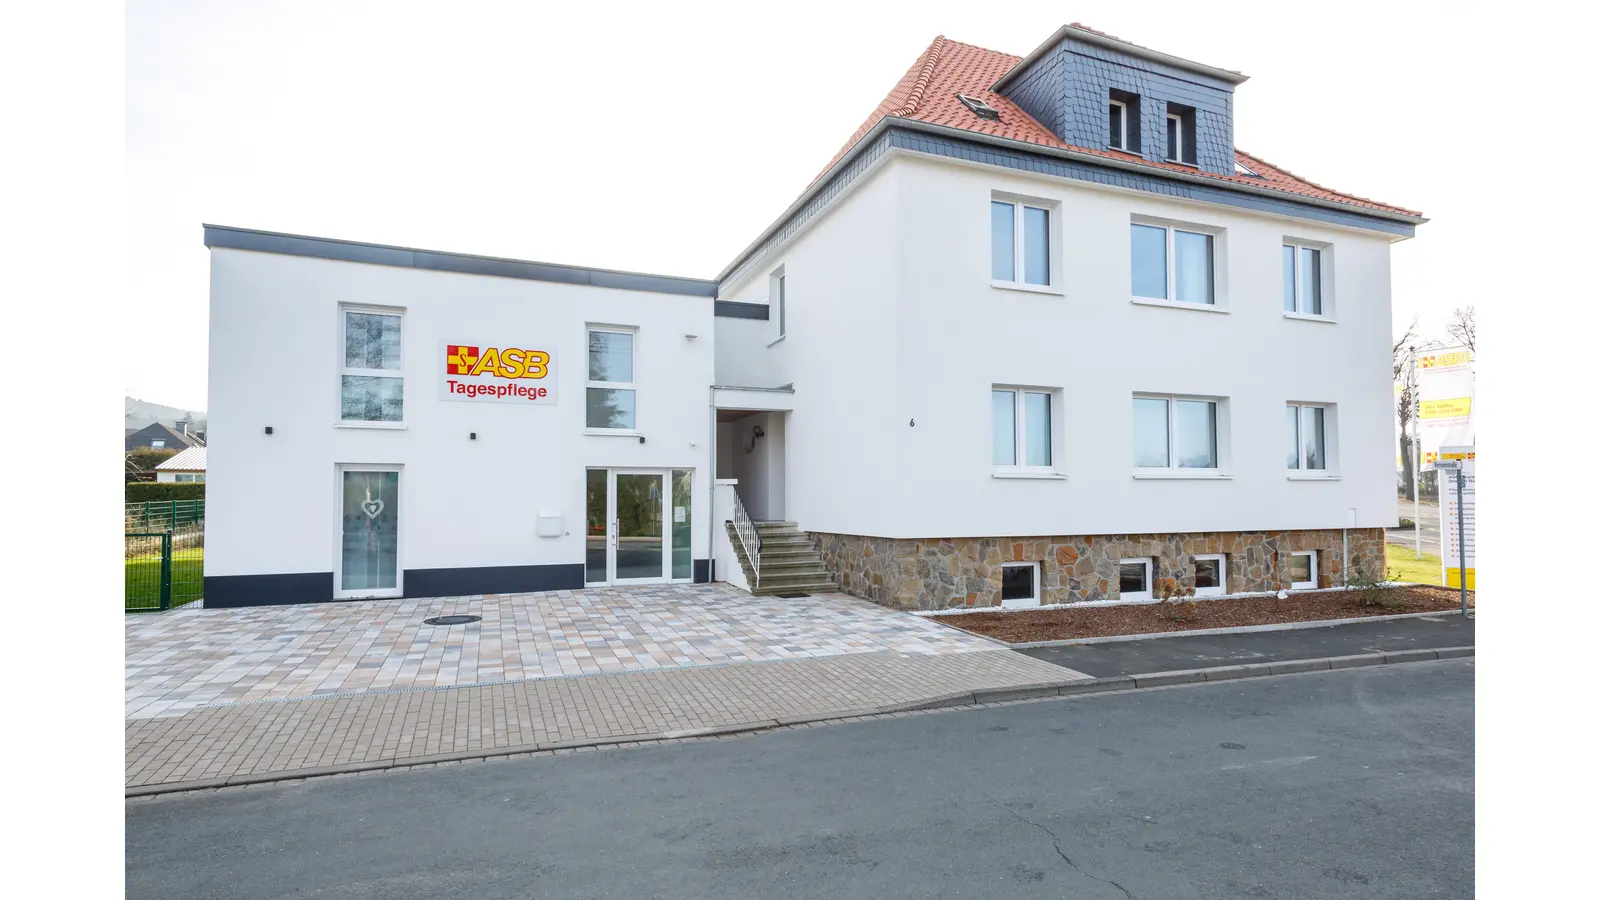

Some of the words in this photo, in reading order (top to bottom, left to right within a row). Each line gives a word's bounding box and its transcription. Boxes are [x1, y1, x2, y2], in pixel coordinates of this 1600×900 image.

[470, 347, 550, 379] ASB
[447, 380, 548, 400] Tagespflege
[910, 418, 915, 427] 6
